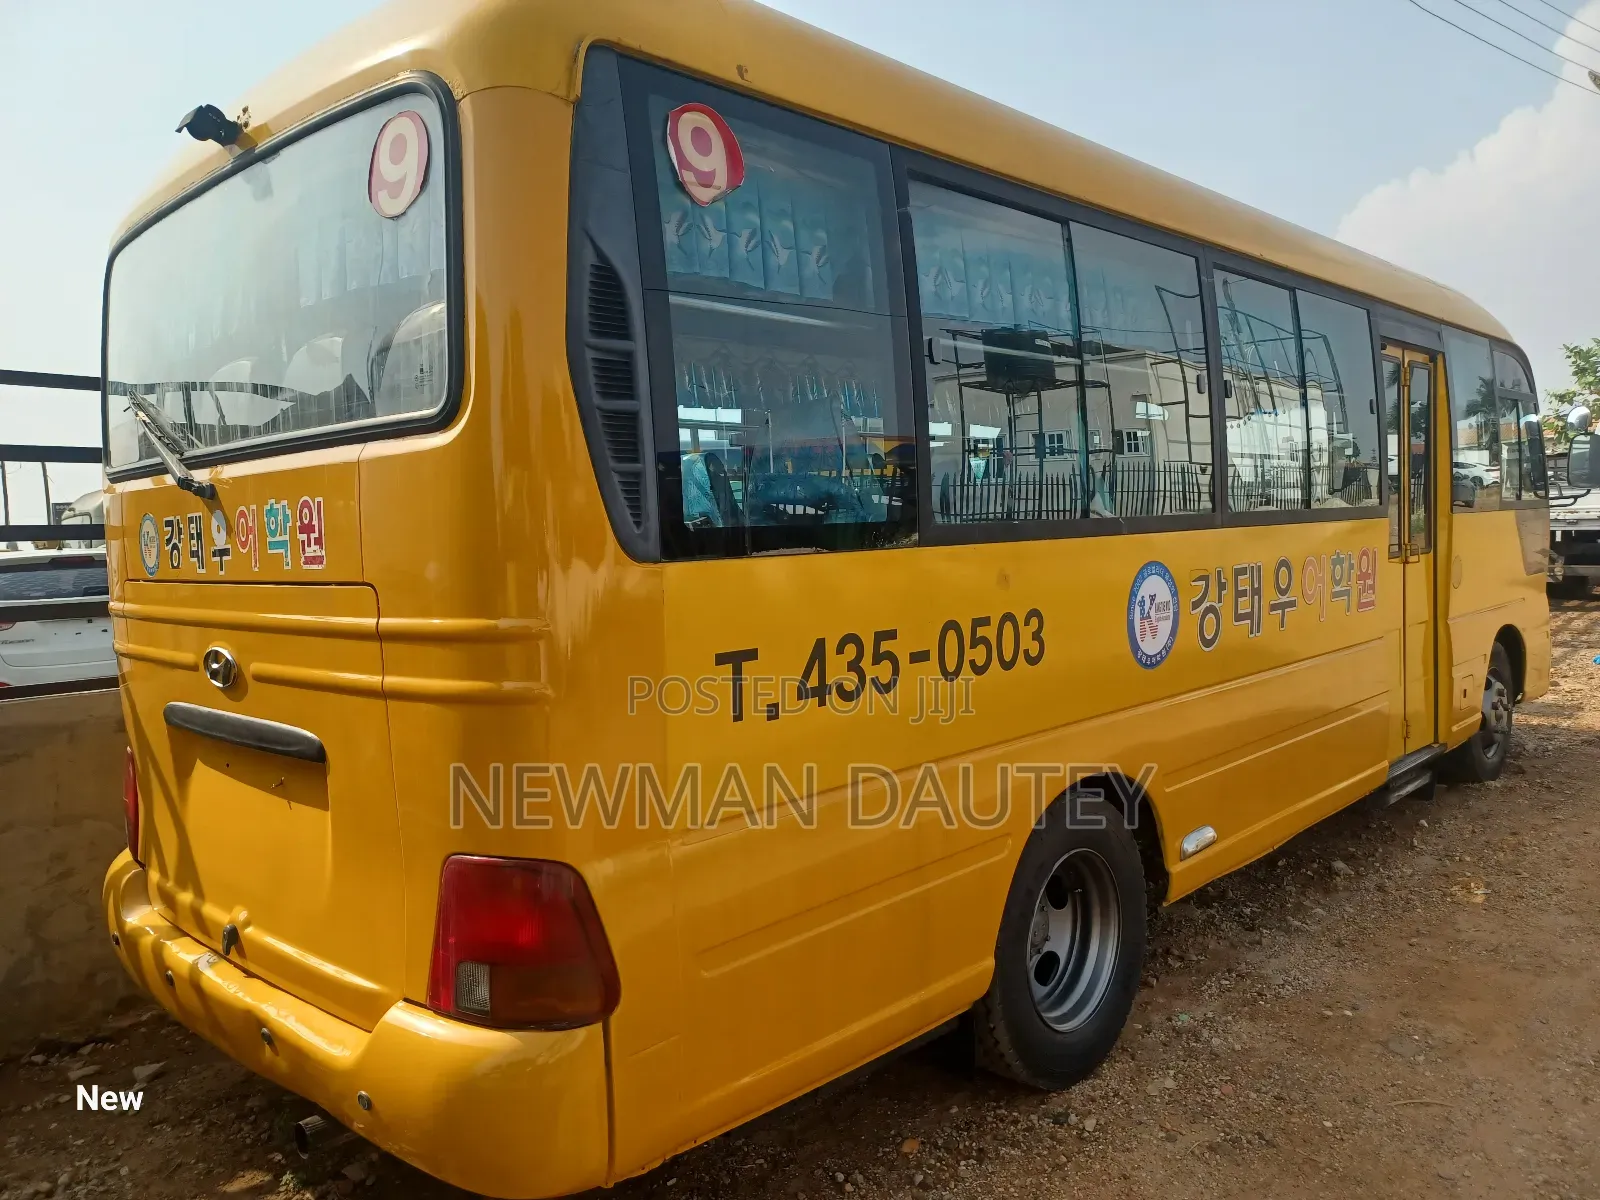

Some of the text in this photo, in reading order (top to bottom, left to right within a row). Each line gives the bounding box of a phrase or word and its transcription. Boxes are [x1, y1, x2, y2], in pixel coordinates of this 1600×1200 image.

[378, 115, 420, 217] 9
[677, 110, 728, 205] 9
[163, 496, 326, 575] 강태우어학원
[1189, 546, 1378, 652] 강태우어학원
[714, 607, 1046, 723] T. 435-0503
